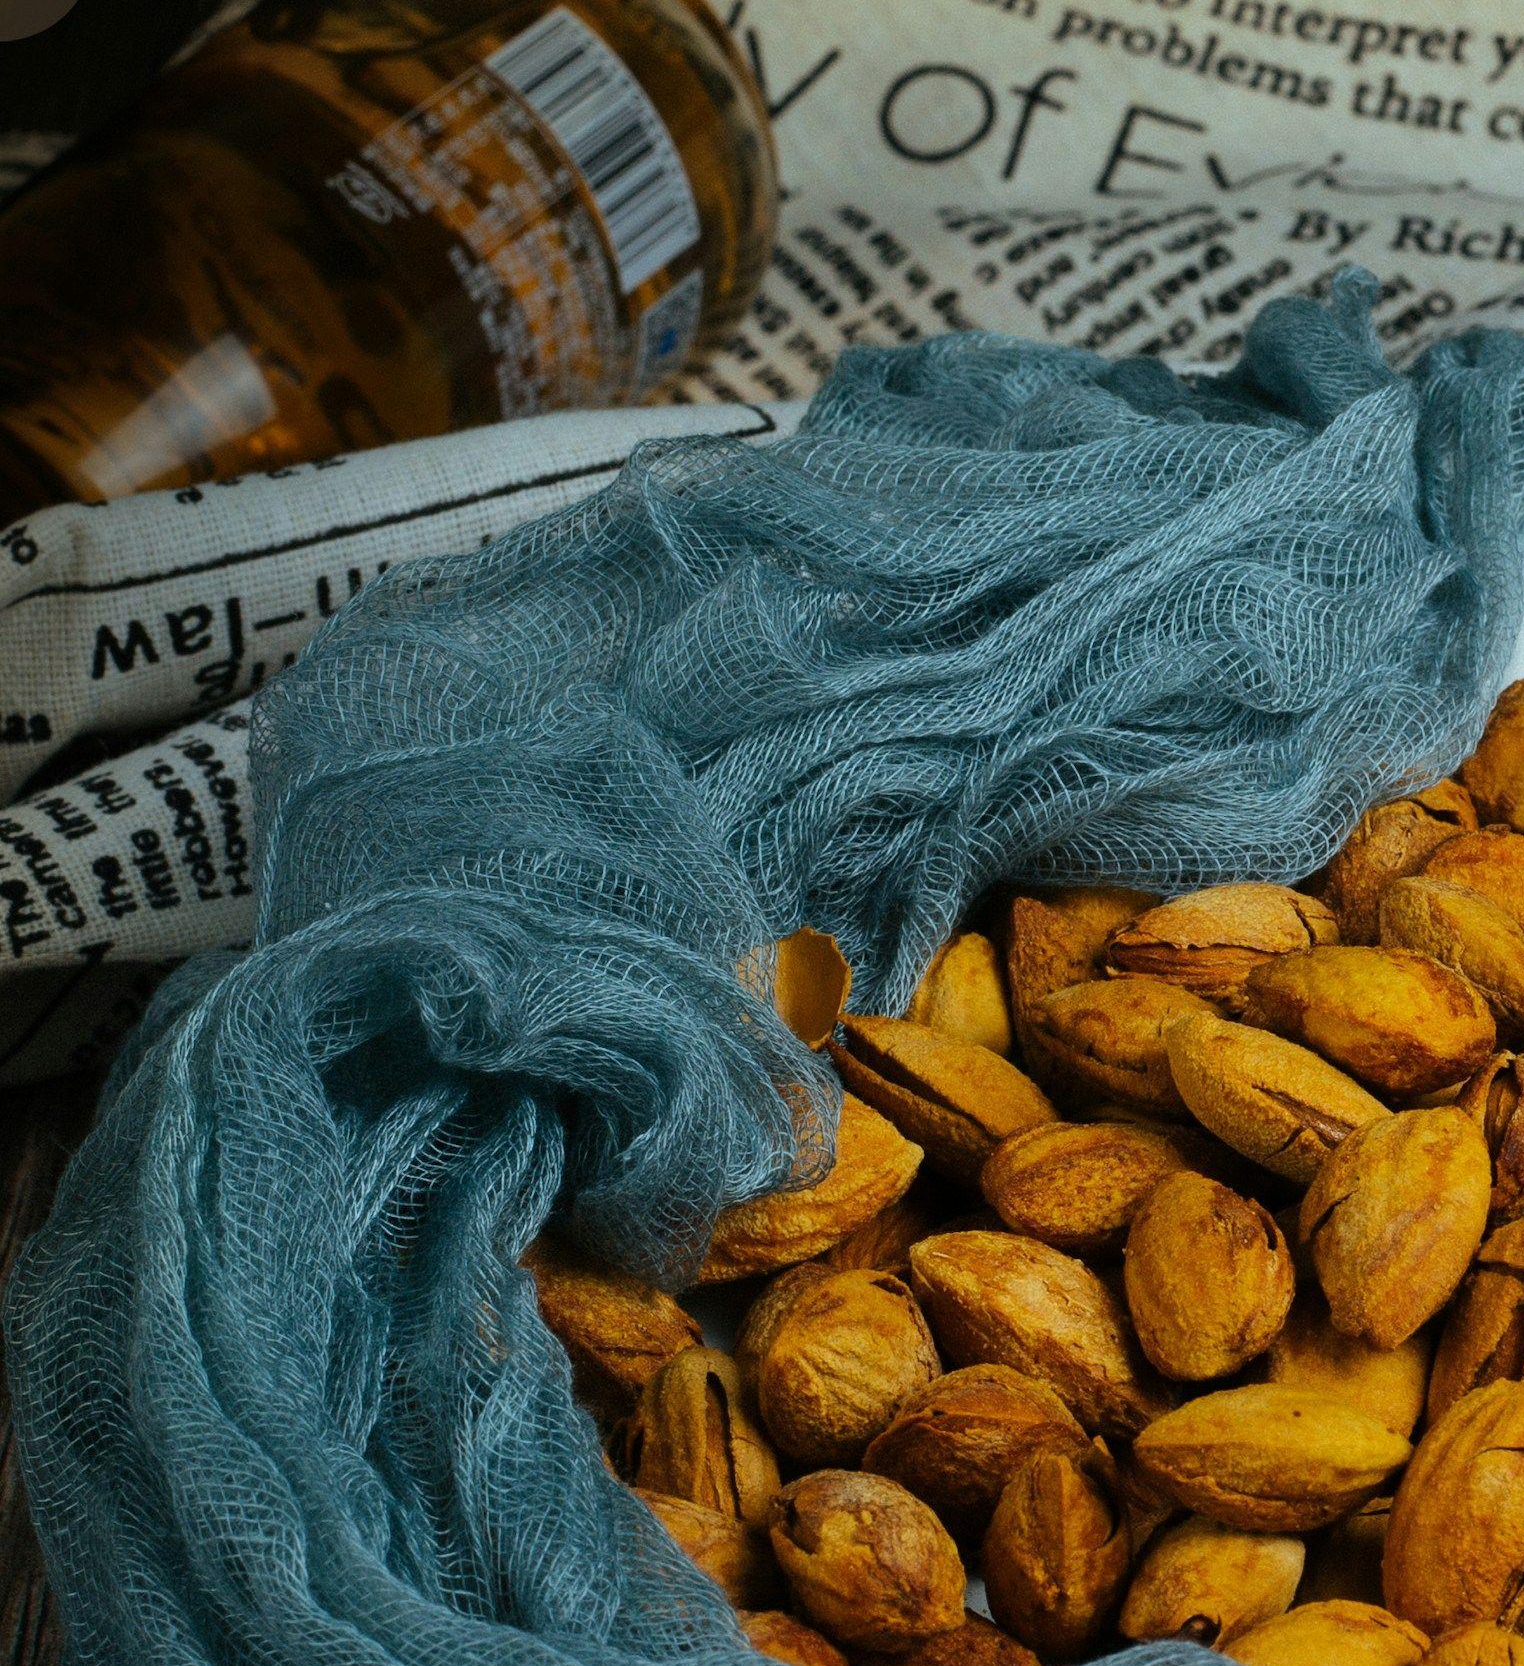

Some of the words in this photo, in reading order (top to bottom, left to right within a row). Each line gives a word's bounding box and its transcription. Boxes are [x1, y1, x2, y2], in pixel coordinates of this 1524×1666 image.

[1054, 3, 1334, 109] problems
[1350, 73, 1471, 136] that
[1286, 209, 1369, 261] By
[0, 858, 42, 960] The
[90, 853, 138, 921] the
